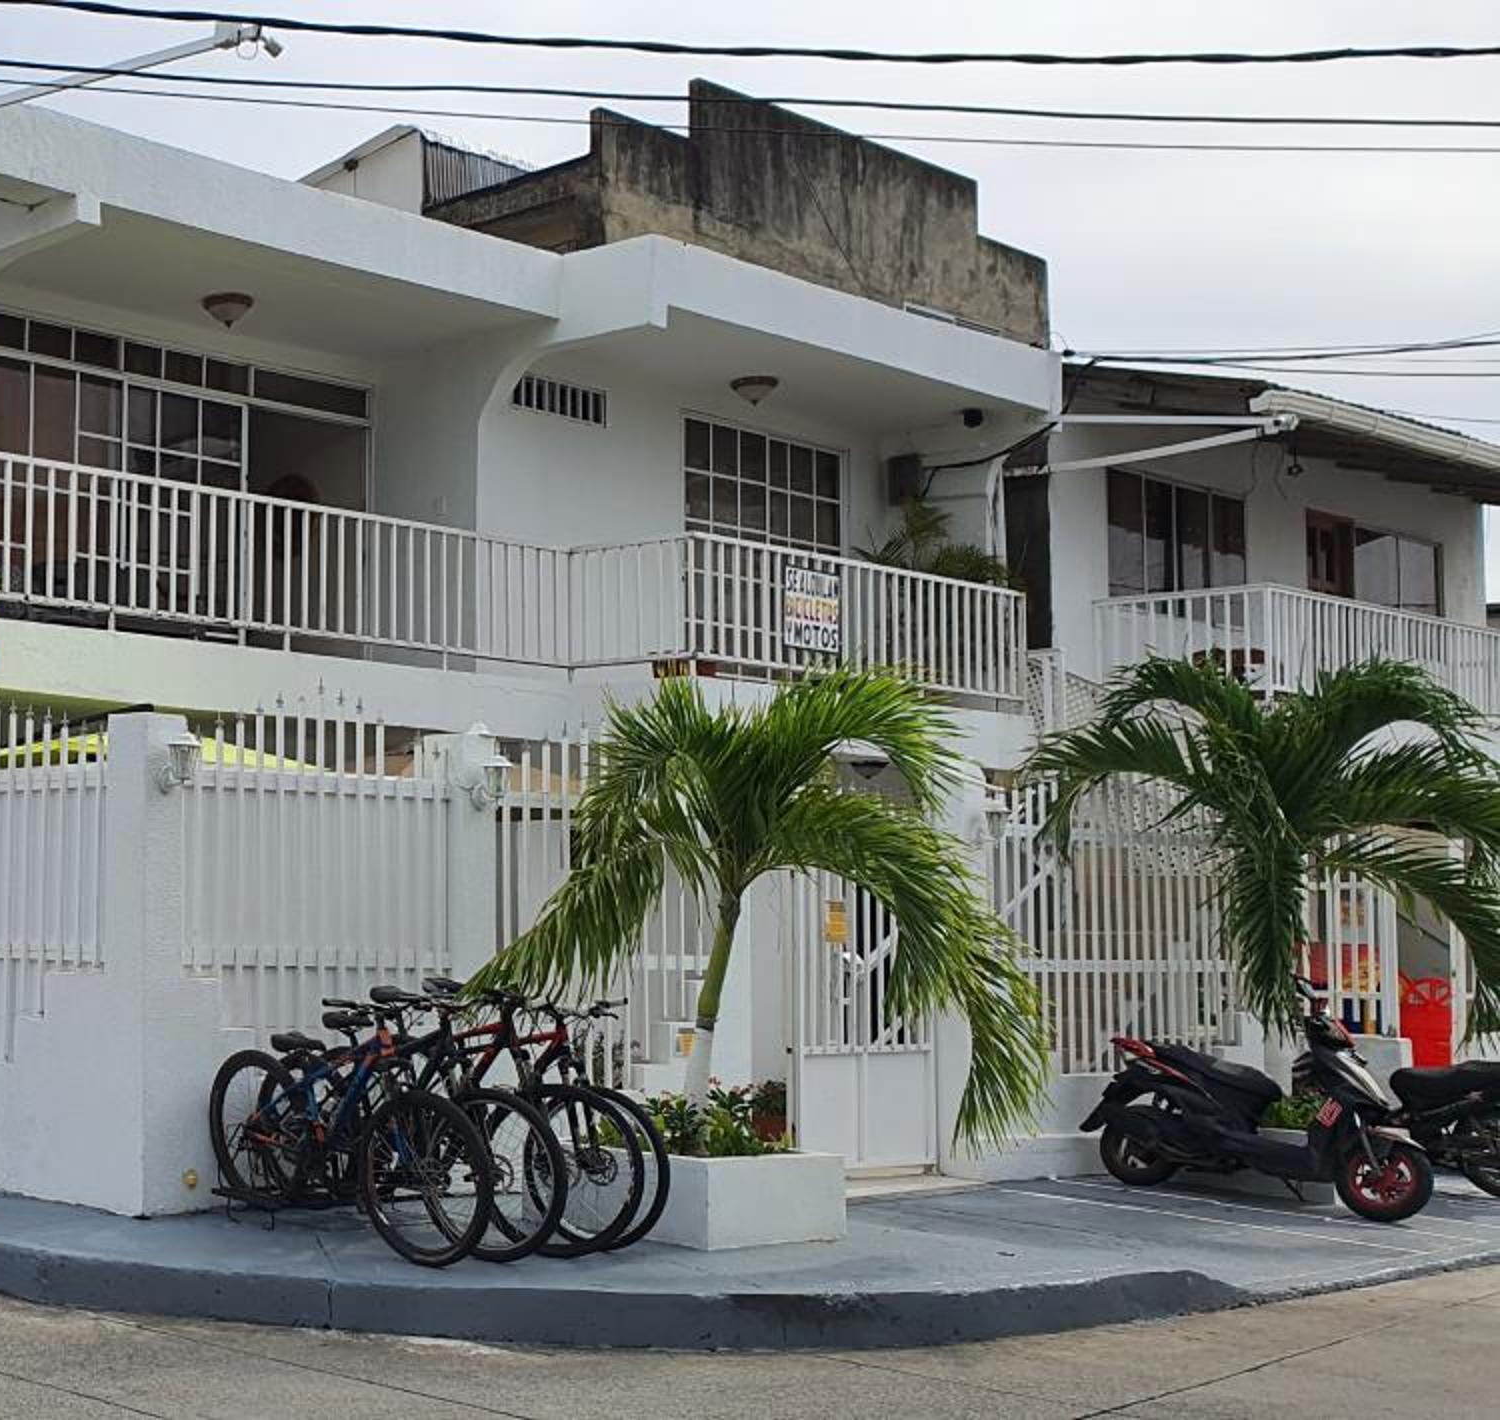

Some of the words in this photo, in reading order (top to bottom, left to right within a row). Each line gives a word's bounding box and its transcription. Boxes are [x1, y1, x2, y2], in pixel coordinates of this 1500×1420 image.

[787, 569, 798, 592] SE
[785, 619, 793, 642] Y
[794, 620, 838, 650] MOTOS
